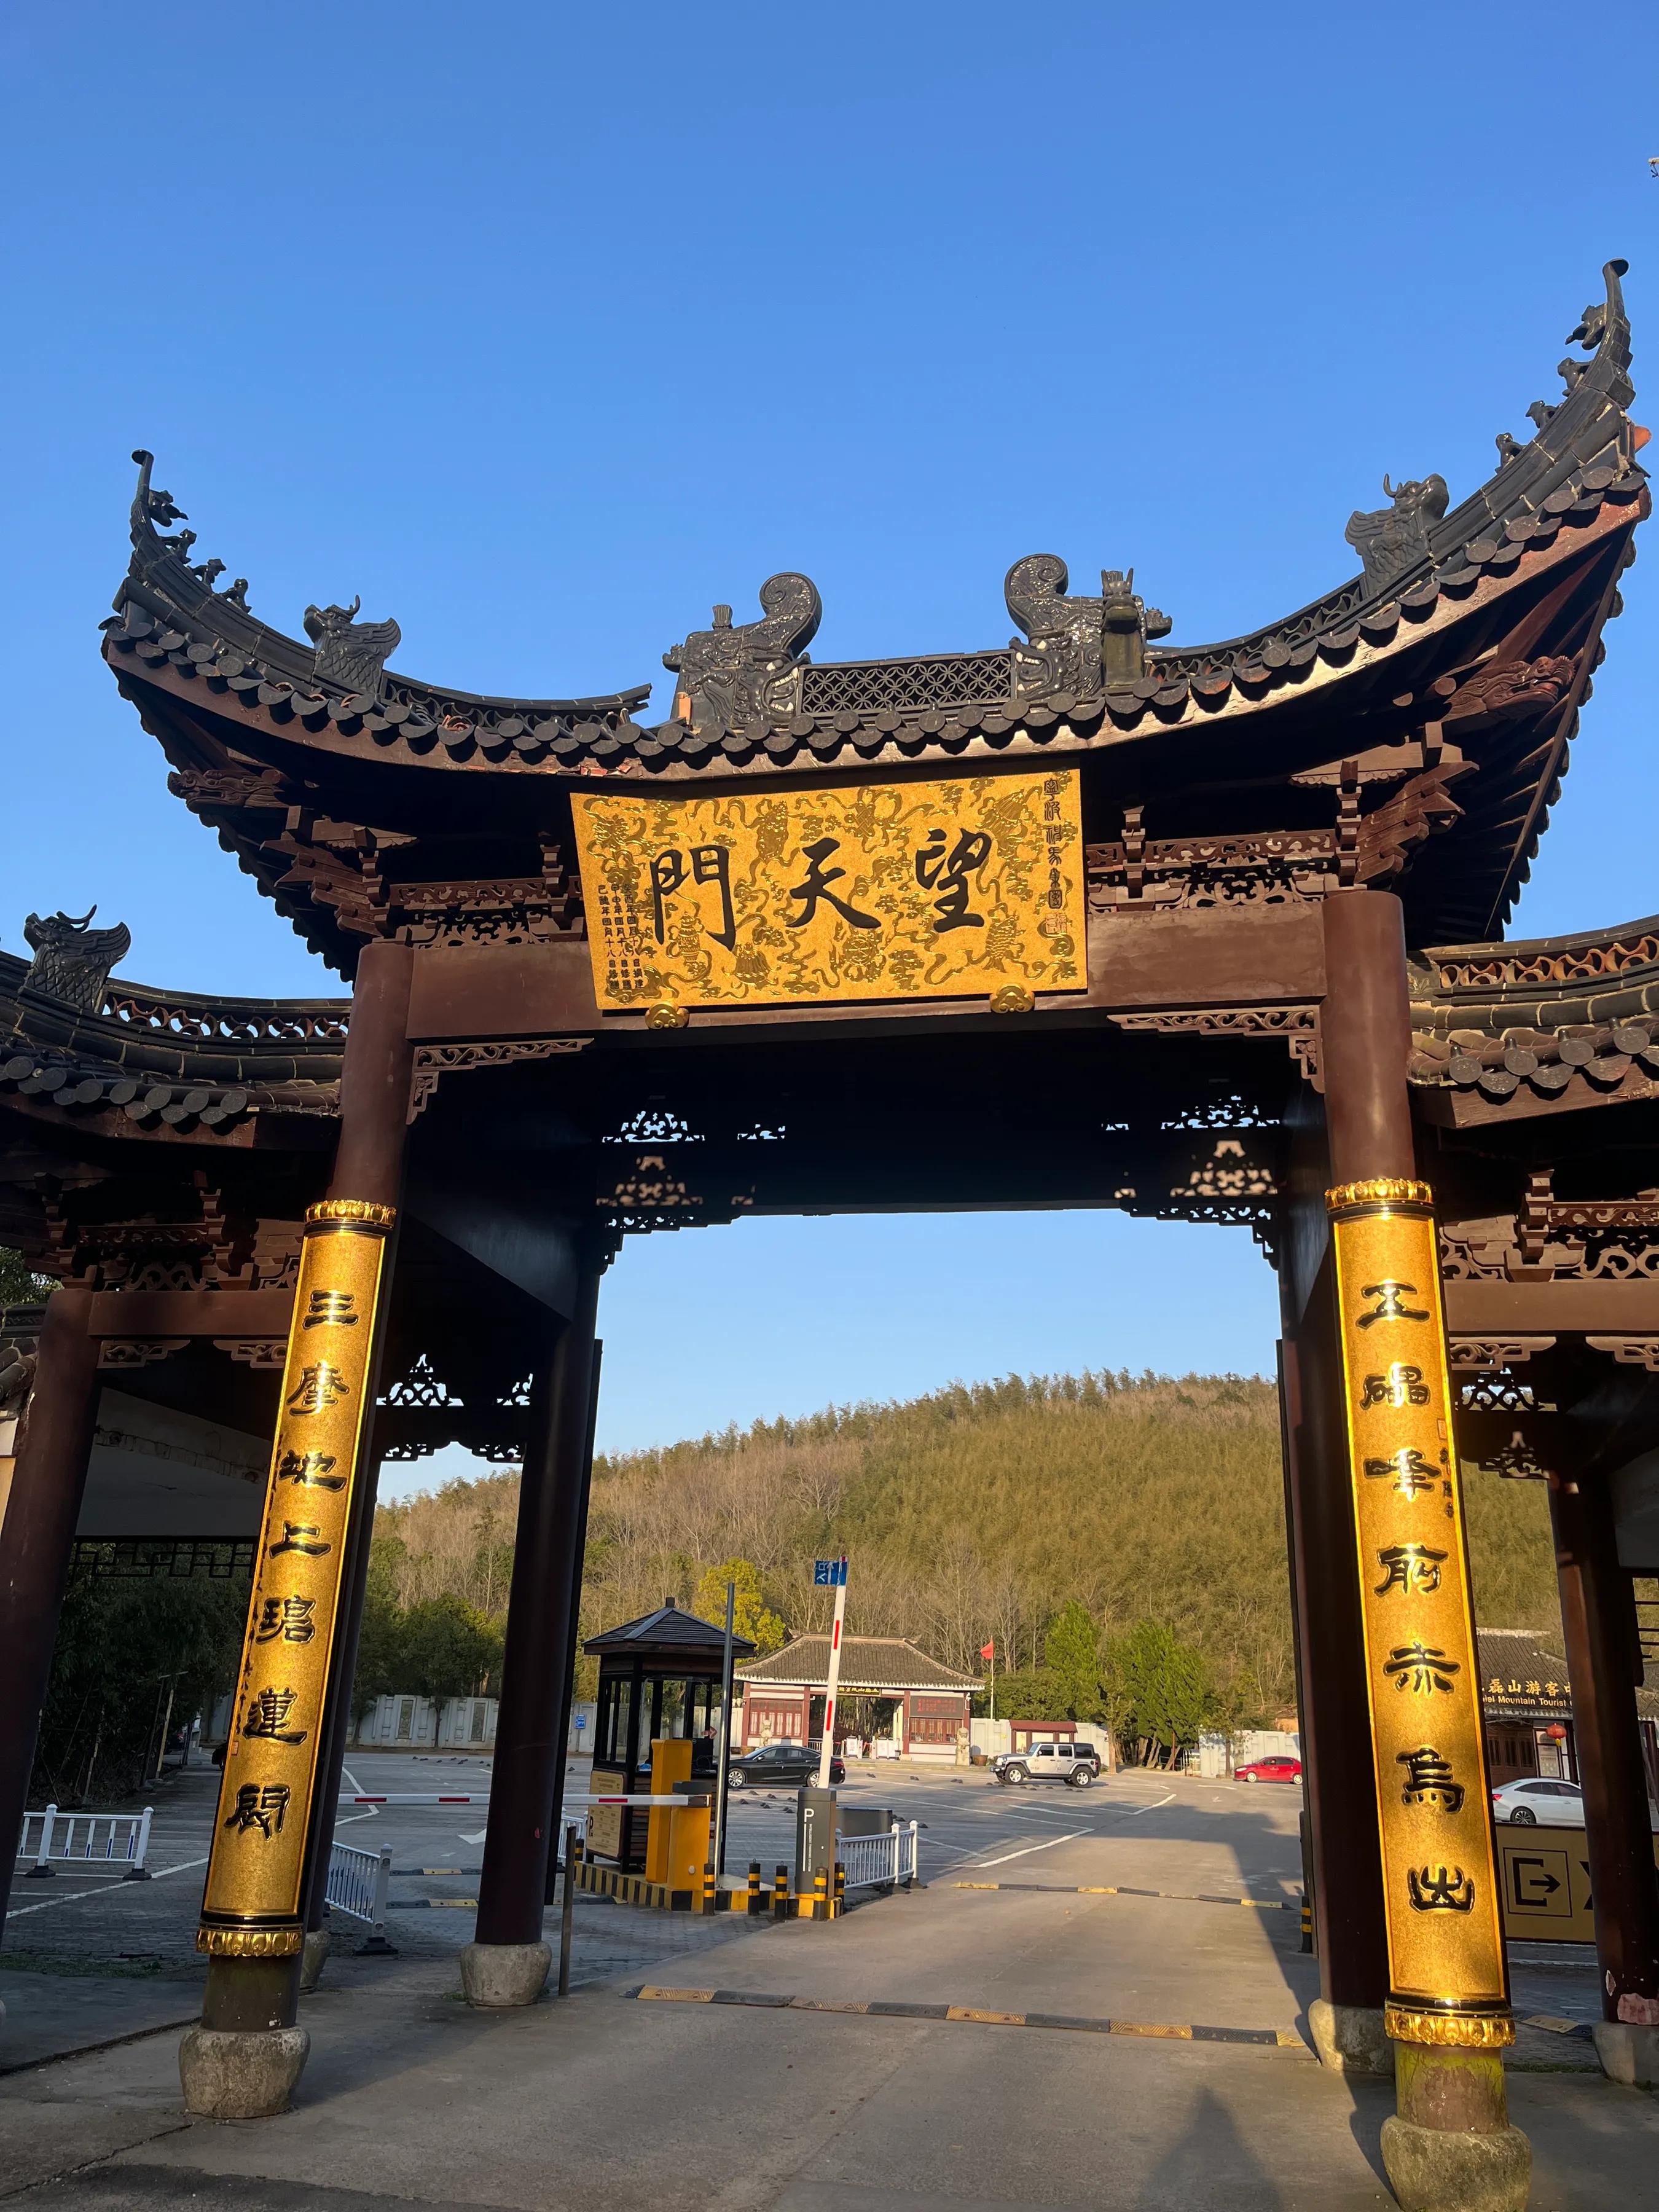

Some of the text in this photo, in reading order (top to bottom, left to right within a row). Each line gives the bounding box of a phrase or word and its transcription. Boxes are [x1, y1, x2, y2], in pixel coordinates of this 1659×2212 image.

[649, 828, 992, 951] 望天門
[1481, 1678, 1571, 1696] 磊山游客中
[1498, 1696, 1535, 1705] Mountain
[1539, 1698, 1566, 1706] Tourist
[804, 1808, 815, 1822] P
